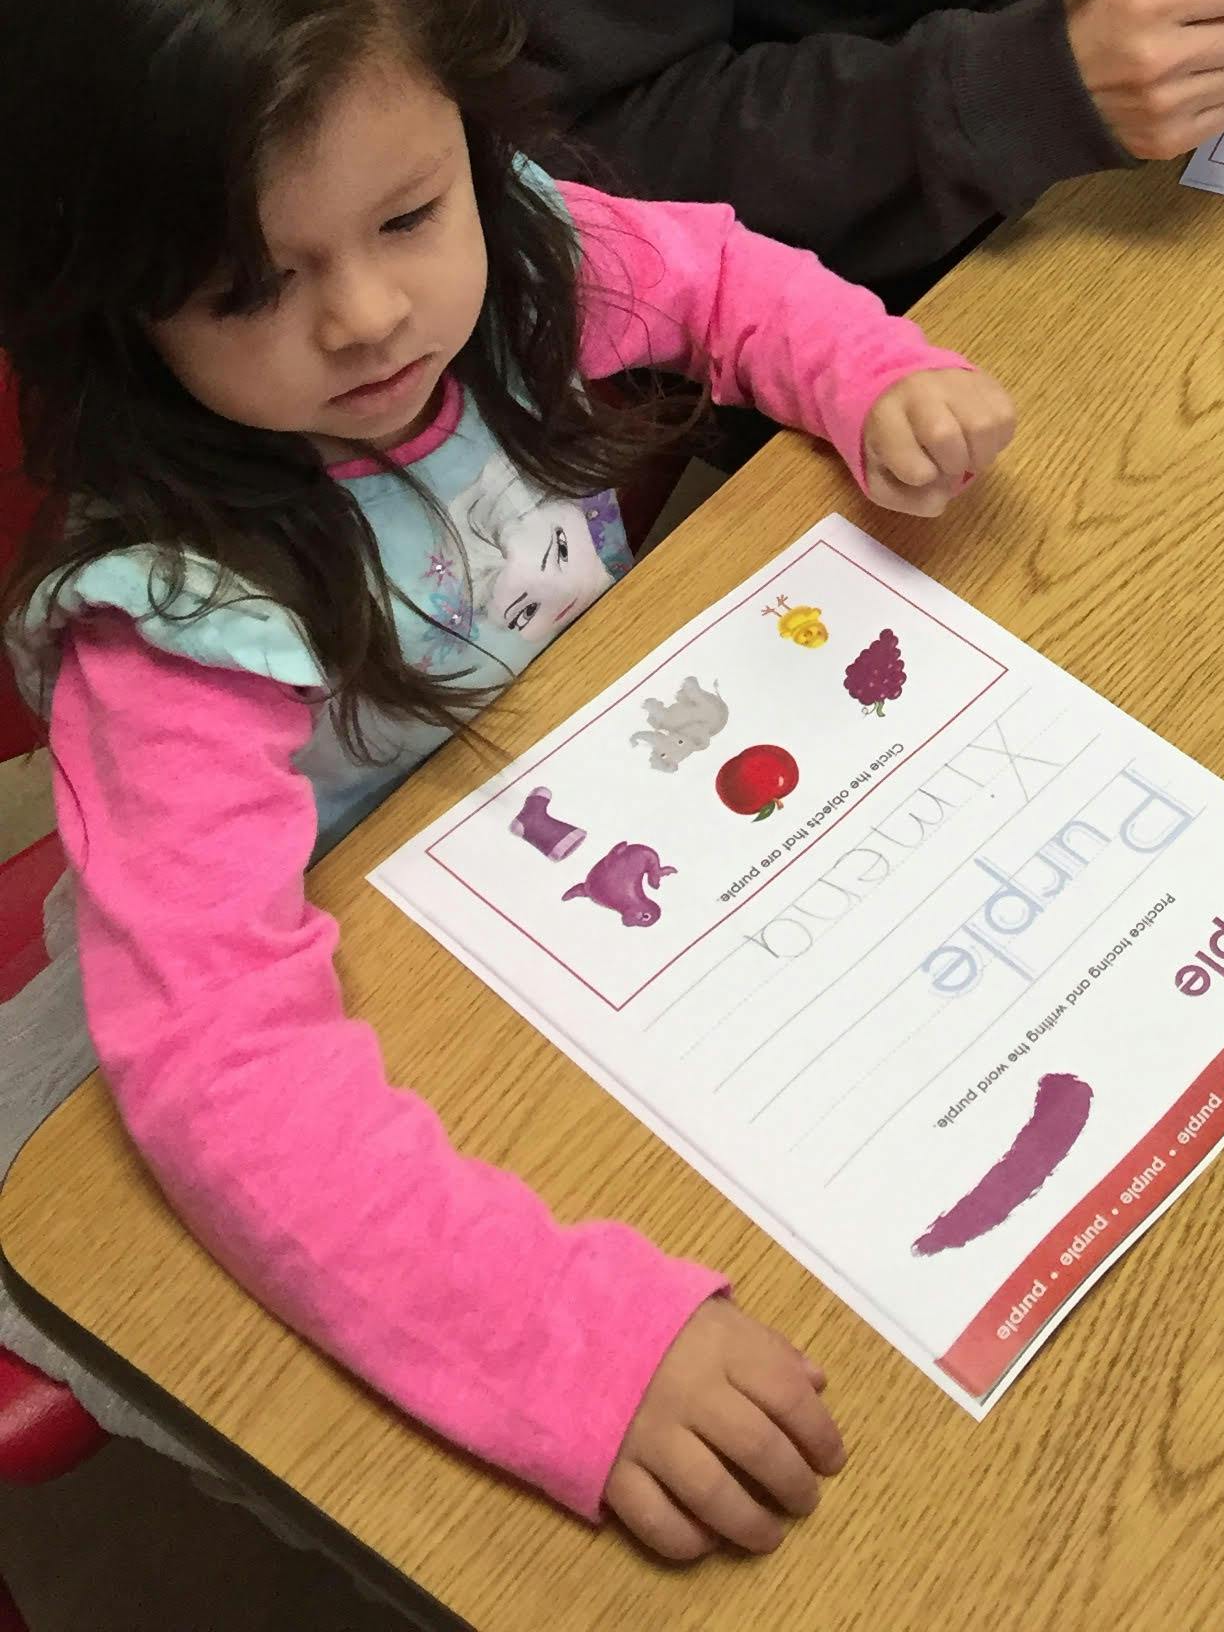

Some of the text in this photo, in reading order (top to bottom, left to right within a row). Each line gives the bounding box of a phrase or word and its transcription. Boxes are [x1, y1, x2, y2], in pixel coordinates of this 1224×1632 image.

[868, 742, 905, 771] Circle
[848, 769, 872, 789] the
[805, 788, 850, 829] objects
[744, 720, 1063, 958] Ximena
[759, 848, 782, 868] are
[780, 826, 810, 852] that
[920, 769, 1196, 996] Purple
[1128, 891, 1176, 938] Practice
[1086, 936, 1133, 979] tracing
[1064, 977, 1091, 1006] and
[1024, 1003, 1068, 1043] writing
[1006, 1041, 1031, 1063] the
[975, 1062, 1009, 1094] word
[1175, 1091, 1223, 1145] purple
[1118, 1154, 1167, 1204] purple
[1058, 1212, 1109, 1266] purple
[995, 1278, 1048, 1340] purple
